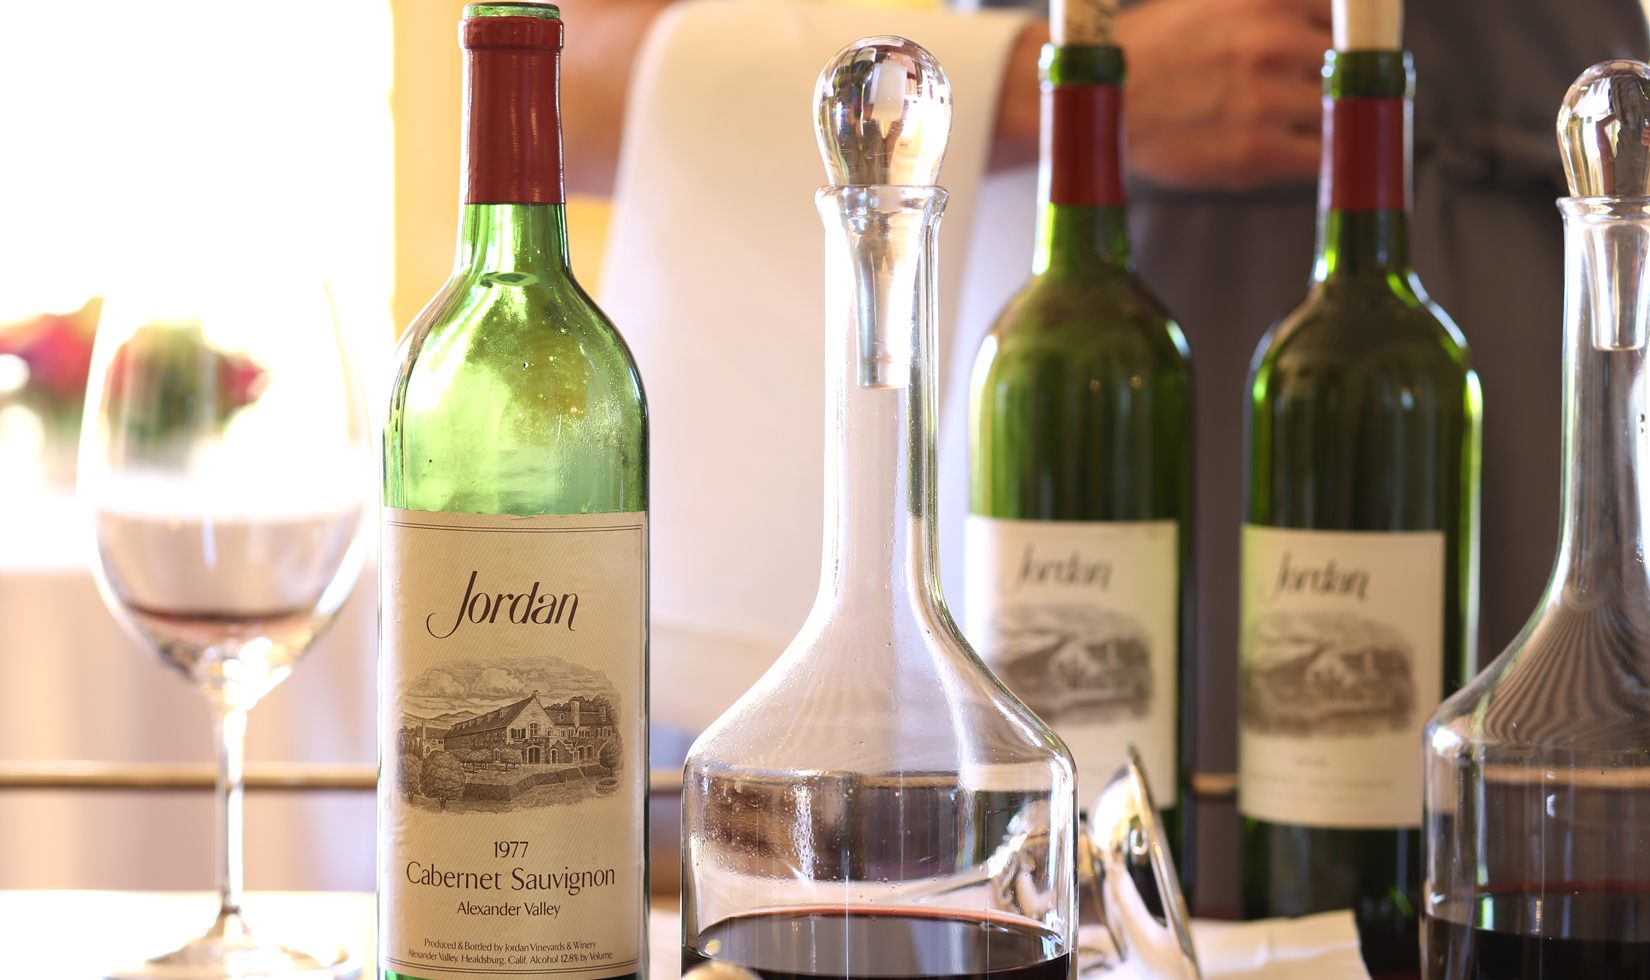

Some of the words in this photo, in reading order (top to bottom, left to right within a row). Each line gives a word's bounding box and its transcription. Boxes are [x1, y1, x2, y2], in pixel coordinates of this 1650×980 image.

[426, 570, 579, 639] Jordan
[494, 841, 529, 858] 1977
[406, 861, 502, 891] Cabernet
[511, 866, 616, 896] Sauvignon
[456, 901, 521, 916] Alexander
[524, 902, 561, 919] Valley
[424, 938, 456, 950] Produced
[457, 942, 463, 951] &
[464, 942, 492, 951] Bottled
[494, 943, 504, 952] by
[504, 943, 529, 953] Jordan
[529, 942, 565, 952] Vineyards
[566, 941, 572, 951] &
[573, 941, 597, 951] Winery
[409, 949, 438, 960] Alexander
[530, 954, 559, 965] Alcohol
[580, 953, 589, 963] by
[589, 951, 613, 961] Volume
